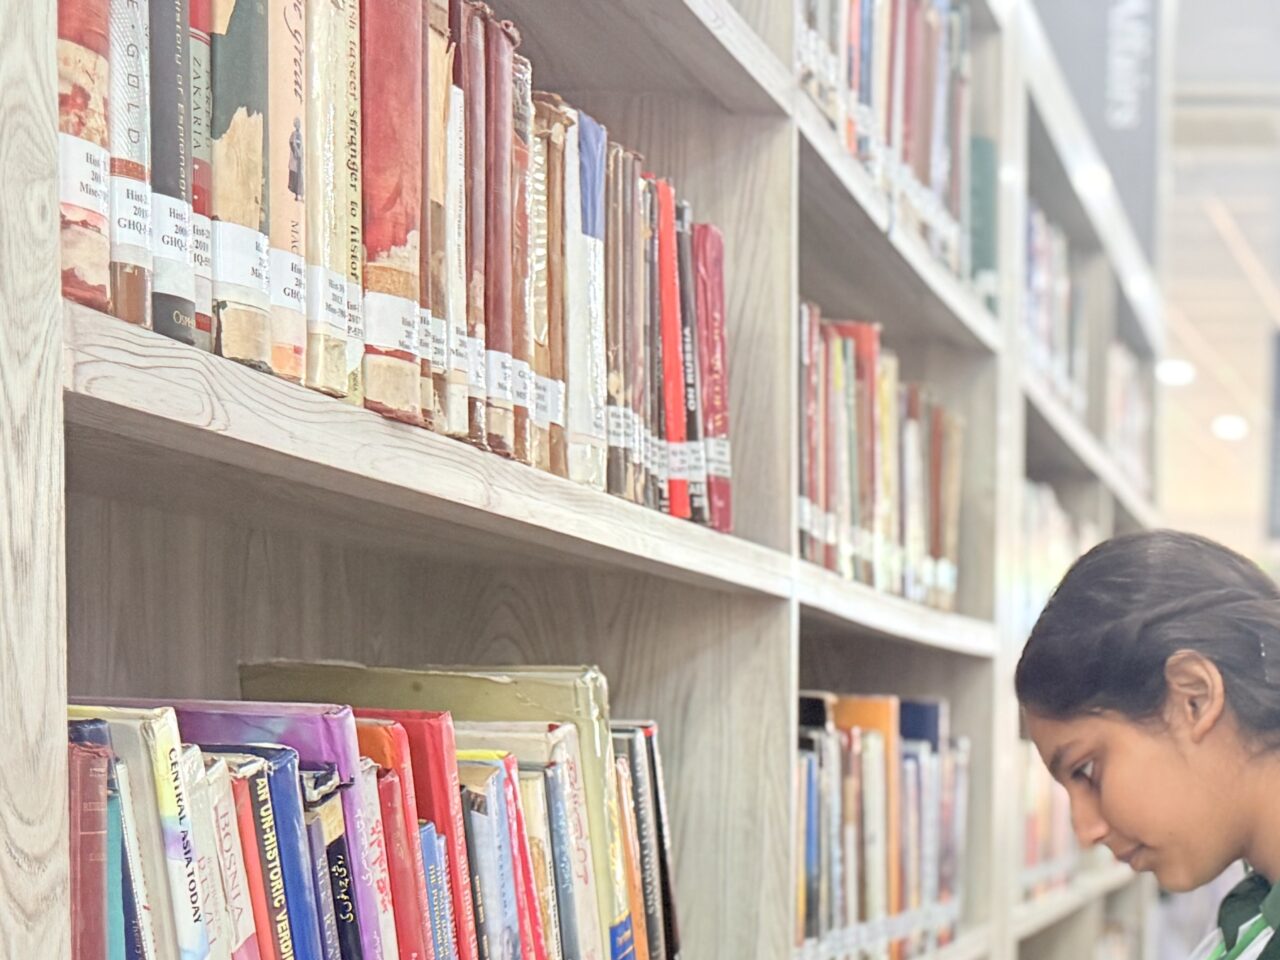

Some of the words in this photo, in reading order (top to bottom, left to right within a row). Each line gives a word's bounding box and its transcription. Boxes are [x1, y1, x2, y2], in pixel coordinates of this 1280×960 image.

[176, 103, 189, 201] Espionag
[350, 225, 361, 282] histor
[683, 326, 694, 386] RUSSIA
[169, 747, 187, 826] CENTRAL
[256, 777, 268, 798] AN
[180, 830, 193, 869] ASIA
[219, 811, 244, 922] BOSNIA
[259, 804, 286, 908] UN-HISTORIC
[186, 870, 203, 924] TODAY
[459, 854, 470, 884] and
[465, 889, 477, 932] more
